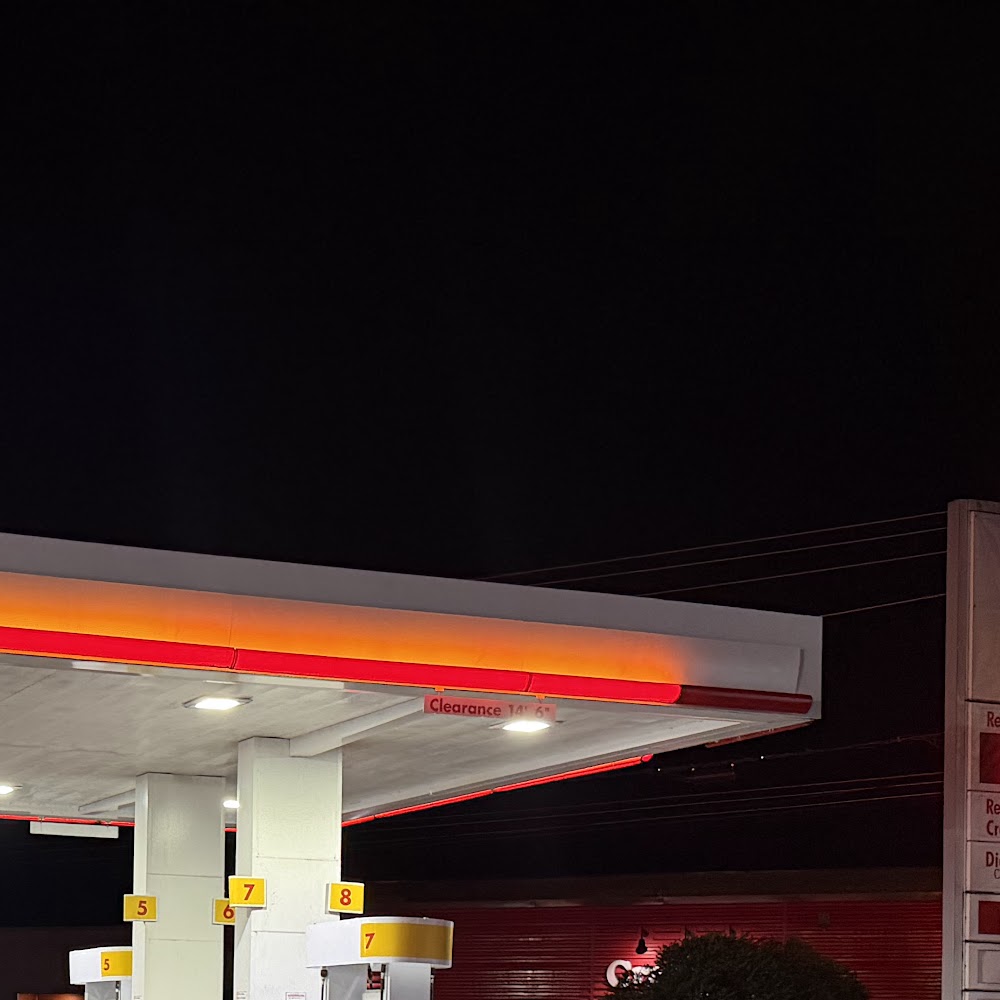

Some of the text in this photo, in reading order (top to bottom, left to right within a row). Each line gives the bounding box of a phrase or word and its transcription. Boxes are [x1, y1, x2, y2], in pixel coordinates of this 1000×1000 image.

[429, 698, 550, 719] Clearance 14' 6"
[986, 820, 1000, 836] Cr
[986, 851, 1000, 868] Di
[243, 884, 255, 901] 7
[339, 888, 352, 906] 8
[137, 900, 148, 916] 5
[223, 904, 235, 919] 6
[365, 932, 376, 950] 7
[103, 959, 110, 971] 5
